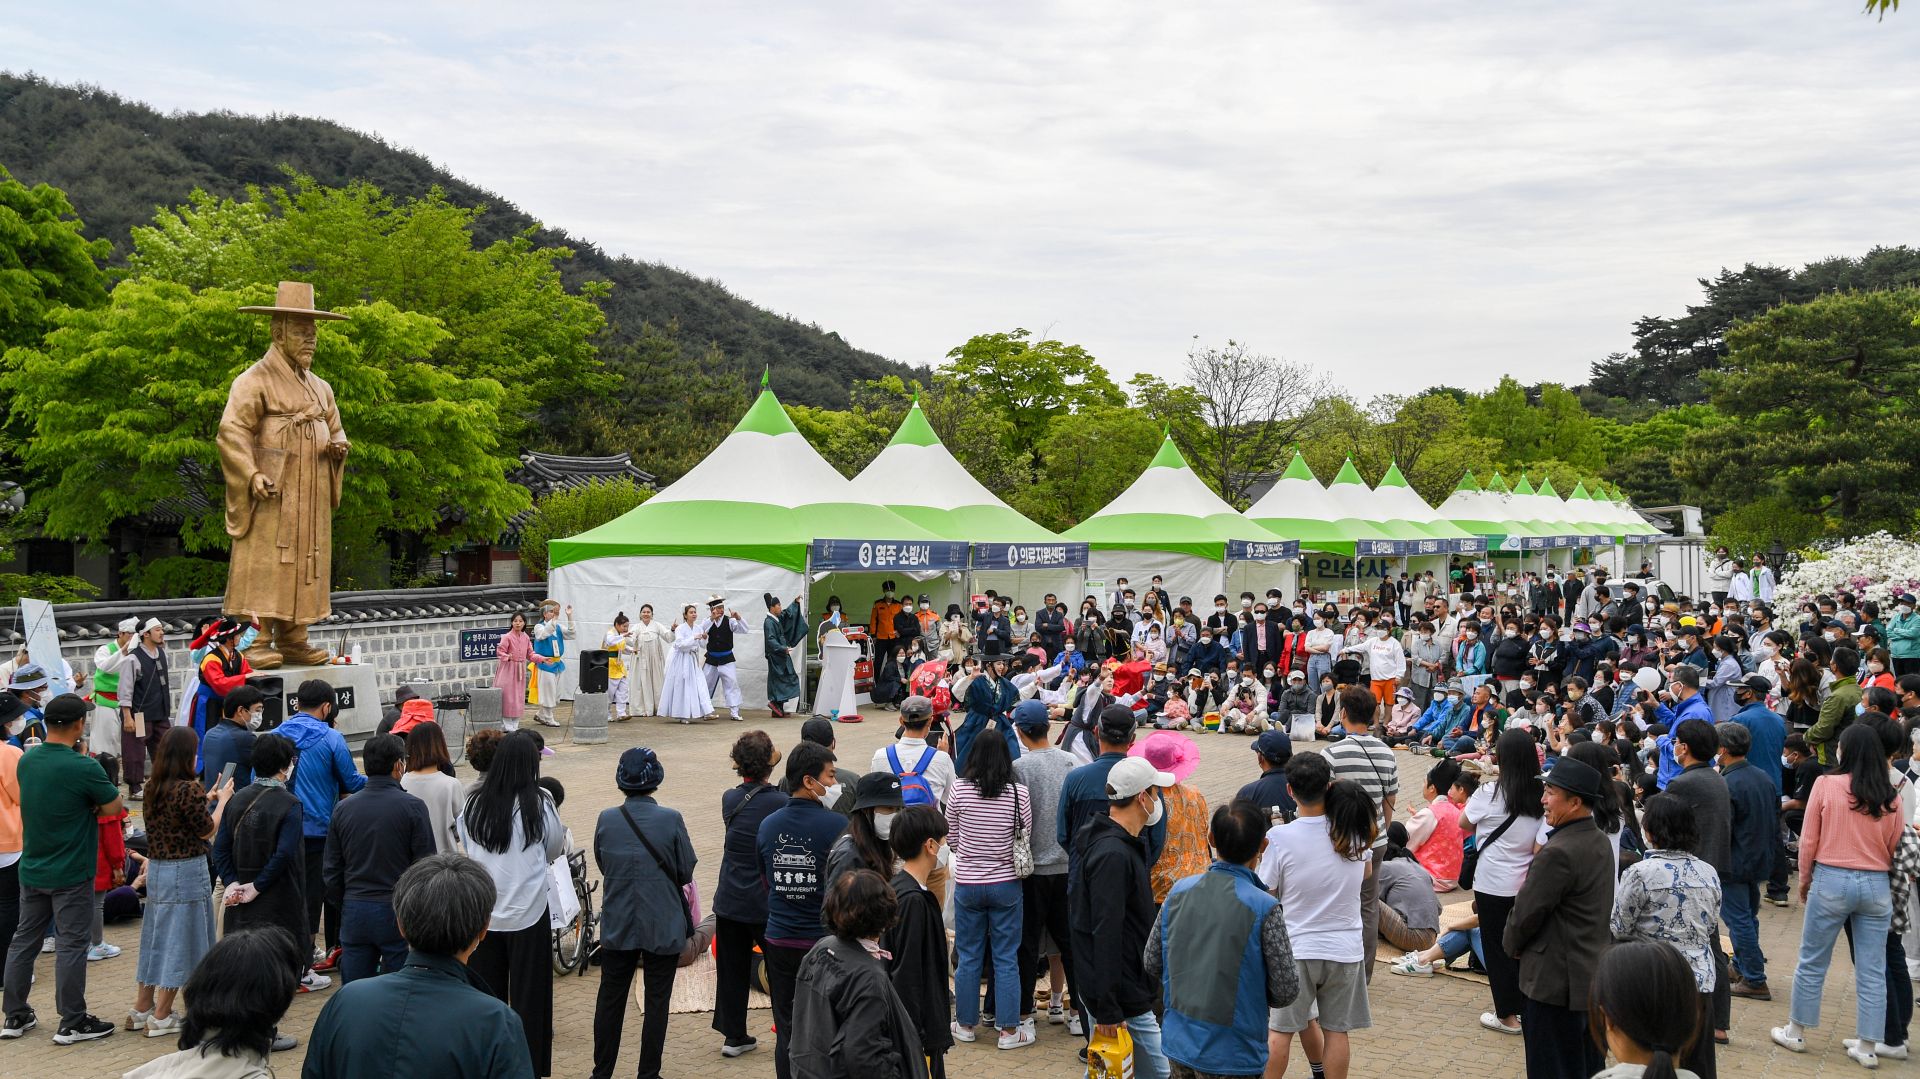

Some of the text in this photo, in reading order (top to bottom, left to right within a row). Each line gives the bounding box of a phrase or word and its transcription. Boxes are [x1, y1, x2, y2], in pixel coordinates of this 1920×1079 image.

[876, 545, 897, 566] 영주
[899, 545, 930, 566] 소방서
[1020, 546, 1066, 564] 의료지원센터
[1317, 559, 1389, 578] 인삼사
[464, 643, 501, 657] 청소년수
